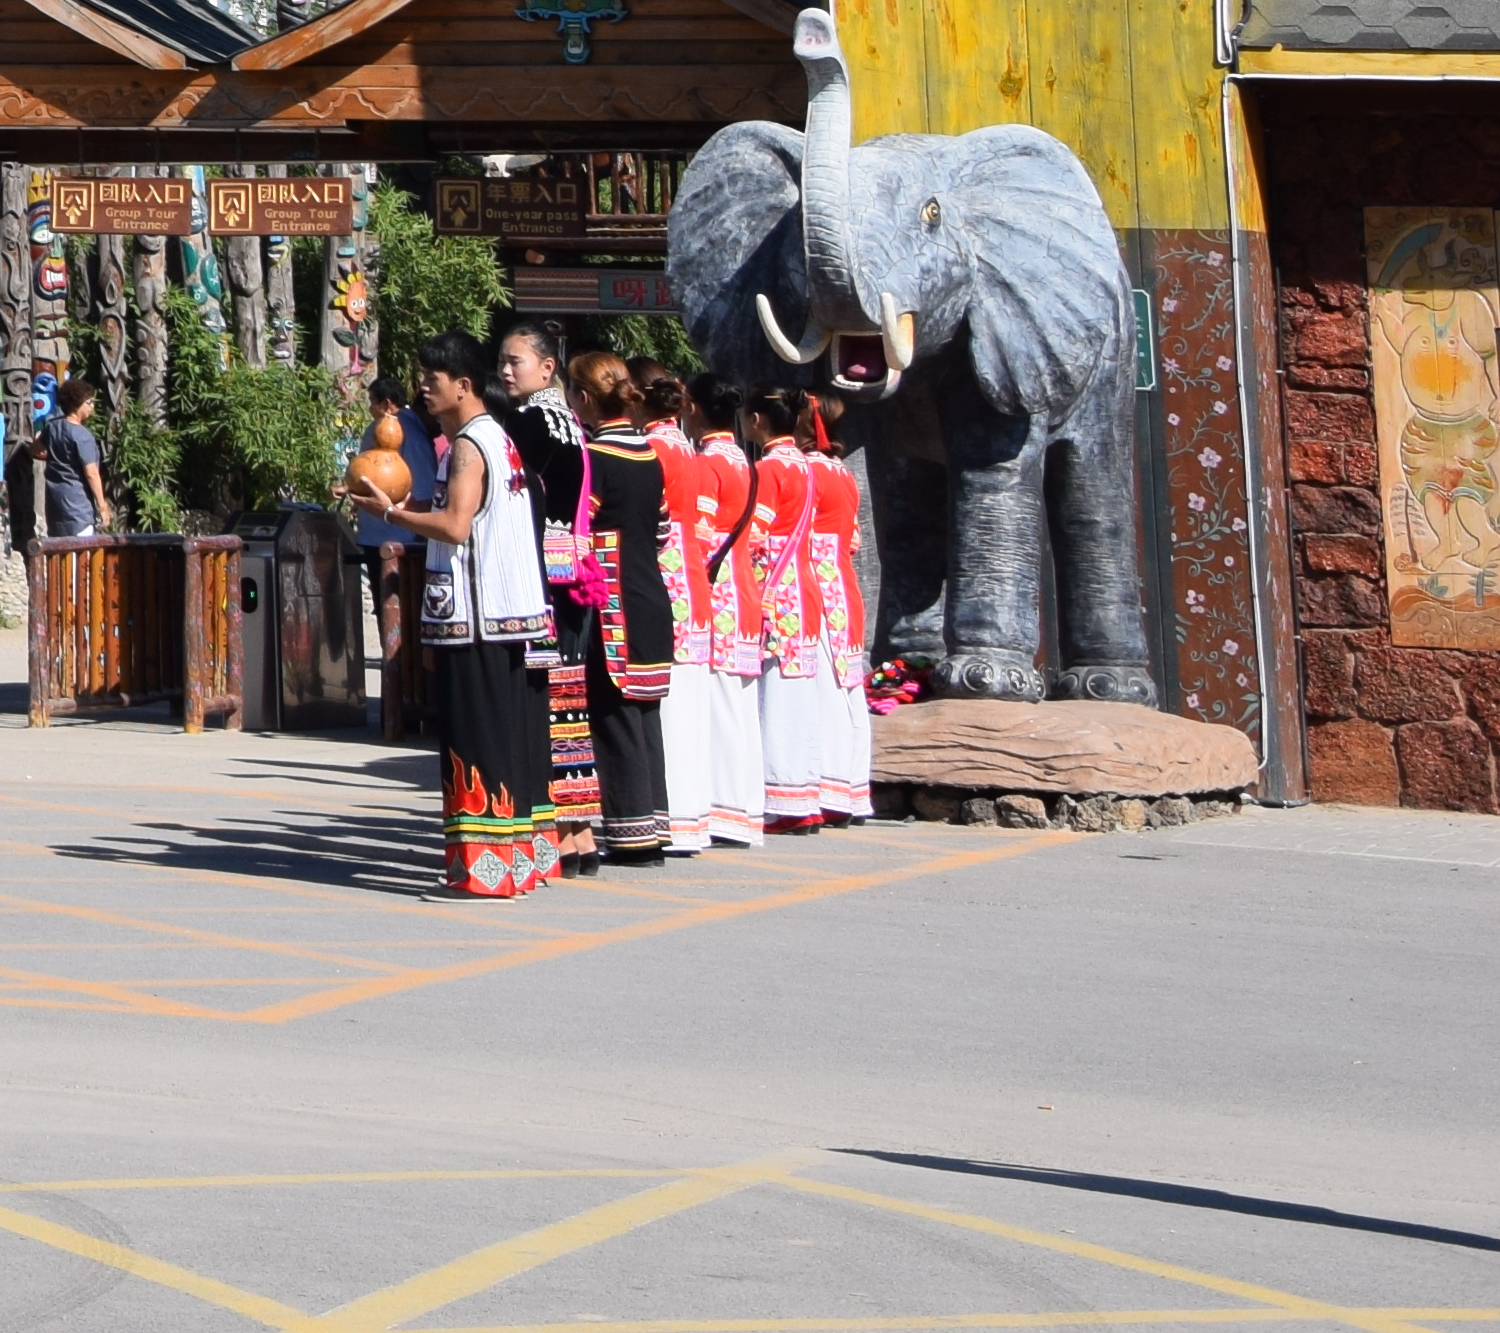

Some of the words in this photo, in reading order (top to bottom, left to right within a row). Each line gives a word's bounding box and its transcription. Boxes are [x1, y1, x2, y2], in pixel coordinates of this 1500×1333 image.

[99, 183, 184, 204] 团队入口
[257, 183, 344, 204] 团队入口
[486, 183, 577, 204] 年票入口
[104, 207, 141, 220] Group
[148, 207, 178, 219] Tour
[263, 208, 301, 220] Group
[308, 208, 339, 219] Tour
[485, 208, 543, 222] One-year
[546, 211, 579, 223] pass
[112, 219, 169, 230] Entrance
[271, 220, 331, 231] Entrance
[502, 222, 564, 233] Entrance
